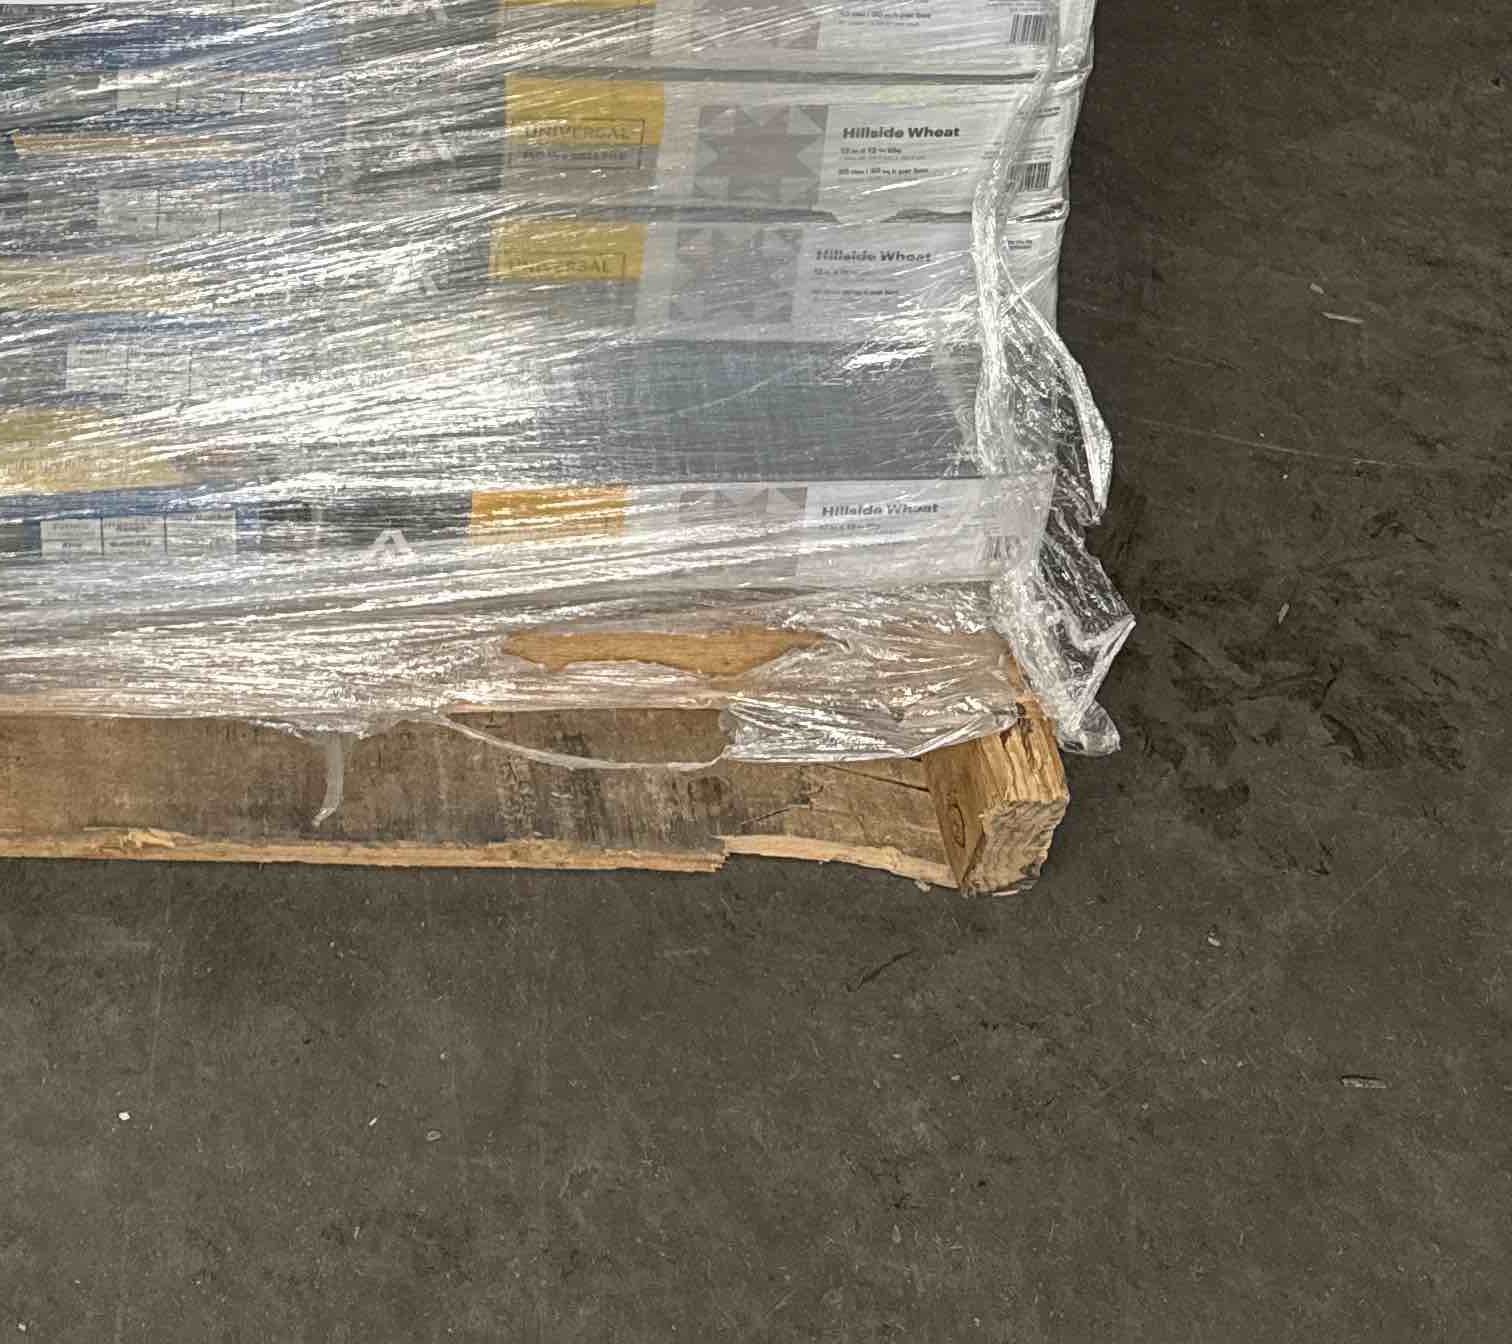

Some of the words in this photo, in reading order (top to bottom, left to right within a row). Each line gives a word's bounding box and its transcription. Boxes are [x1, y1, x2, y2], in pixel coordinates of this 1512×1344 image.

[842, 126, 905, 139] Hillside
[907, 126, 961, 139] Wheat
[815, 250, 877, 263] Hillside
[879, 251, 932, 263] Wheat
[821, 504, 883, 517] Hillside
[885, 502, 939, 514] Wheat
